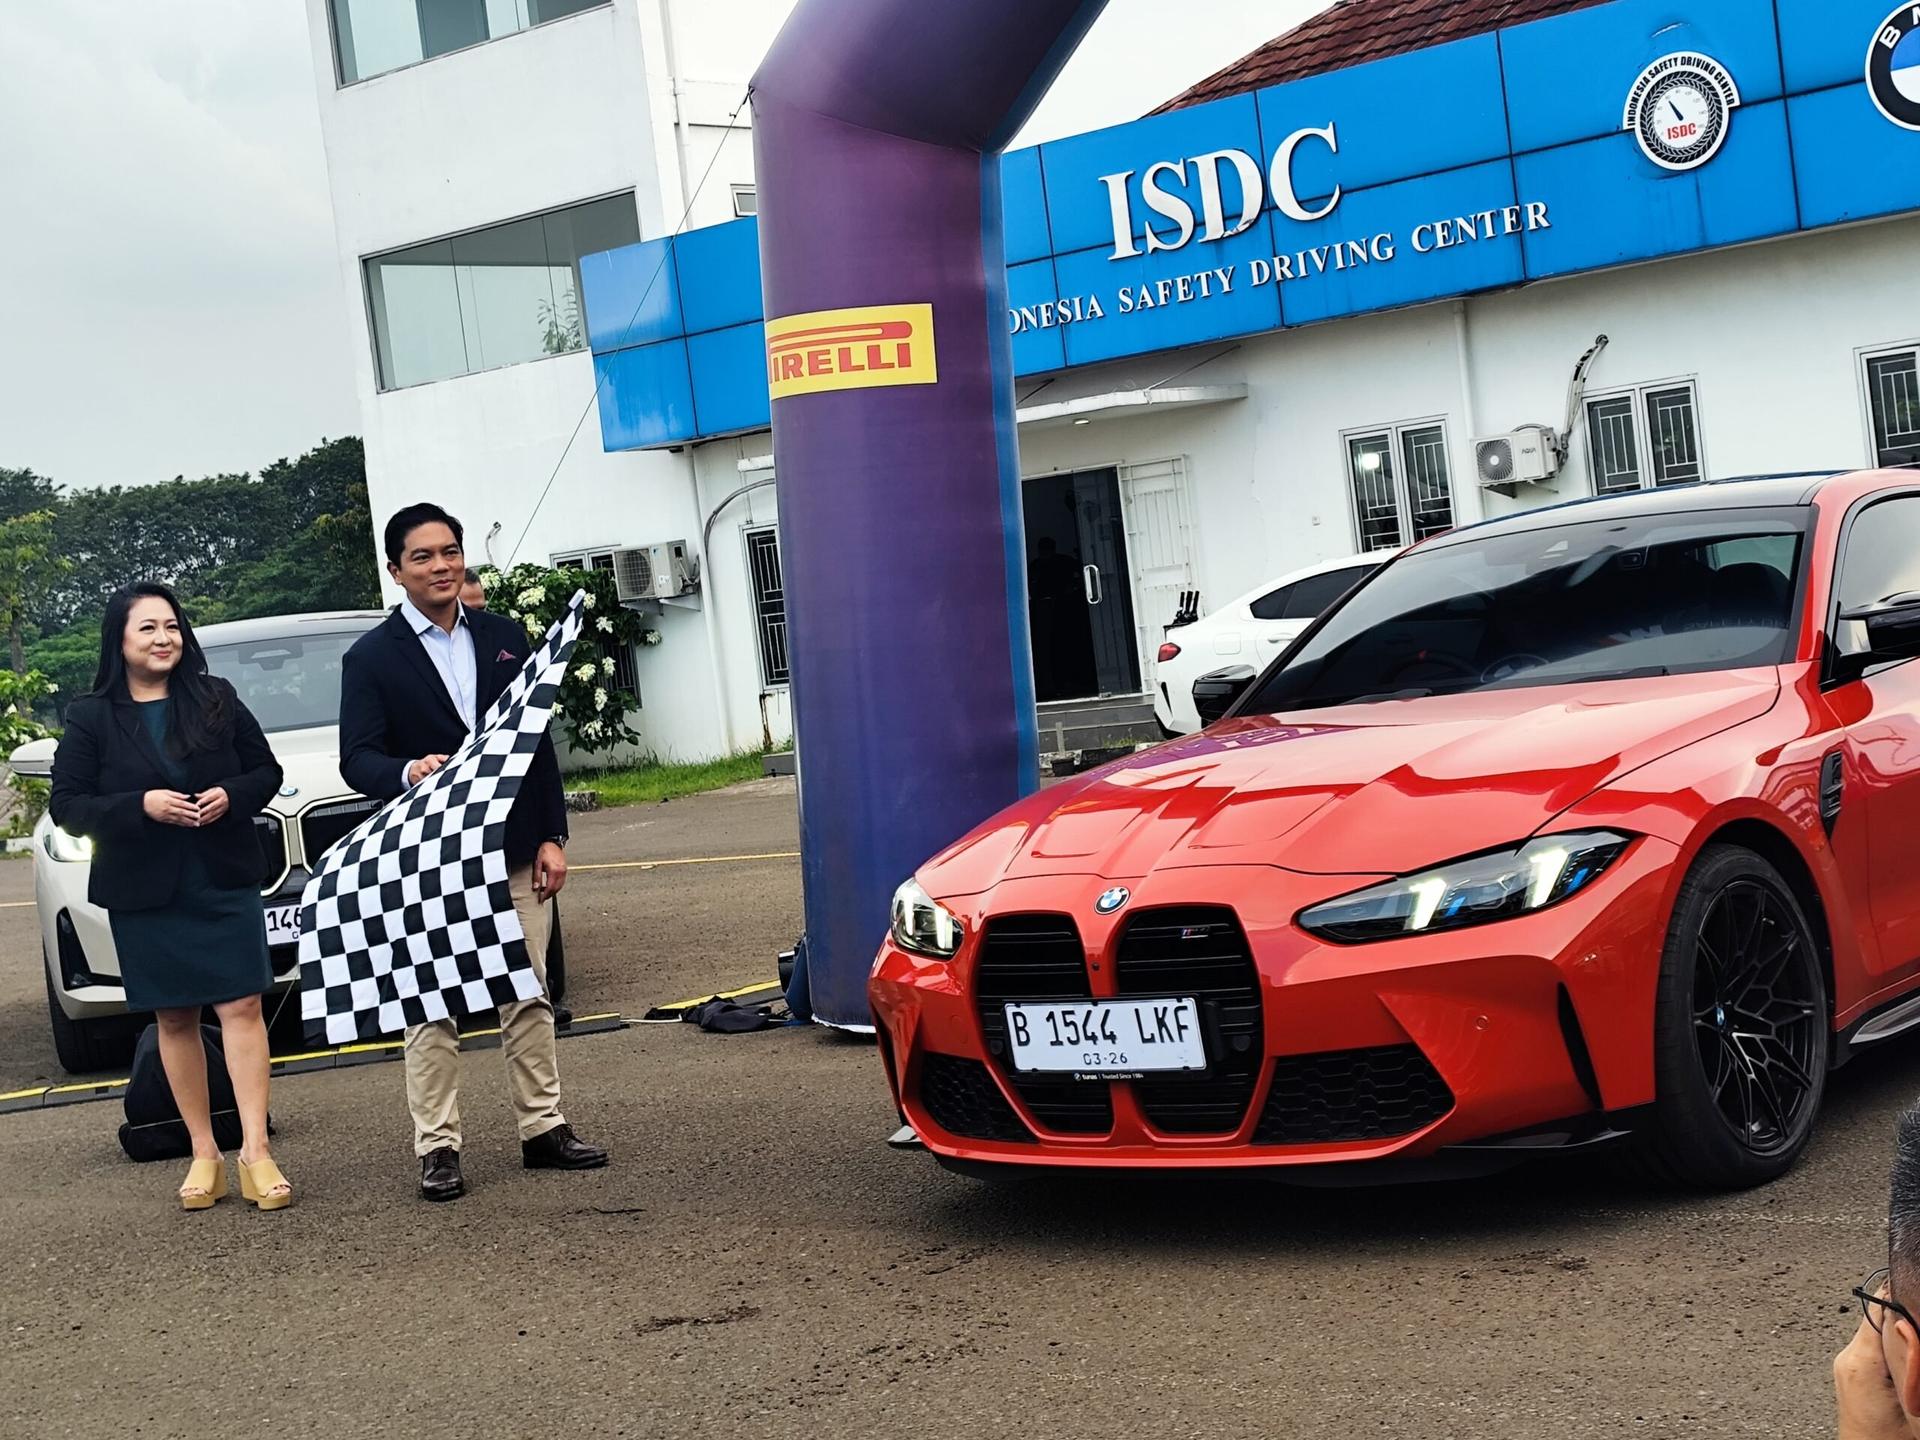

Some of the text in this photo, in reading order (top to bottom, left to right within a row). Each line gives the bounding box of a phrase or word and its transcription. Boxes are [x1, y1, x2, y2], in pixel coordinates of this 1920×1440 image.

[1627, 56, 1736, 127] INDONESIA SAFETY DRIVING CENTER
[1667, 122, 1698, 140] ISDC
[1098, 121, 1341, 261] ISDC
[1118, 265, 1236, 313] SAFETY
[1248, 231, 1396, 287] DRIVING
[1411, 201, 1551, 253] CENTER
[1011, 1005, 1189, 1047] B 1544 LKF
